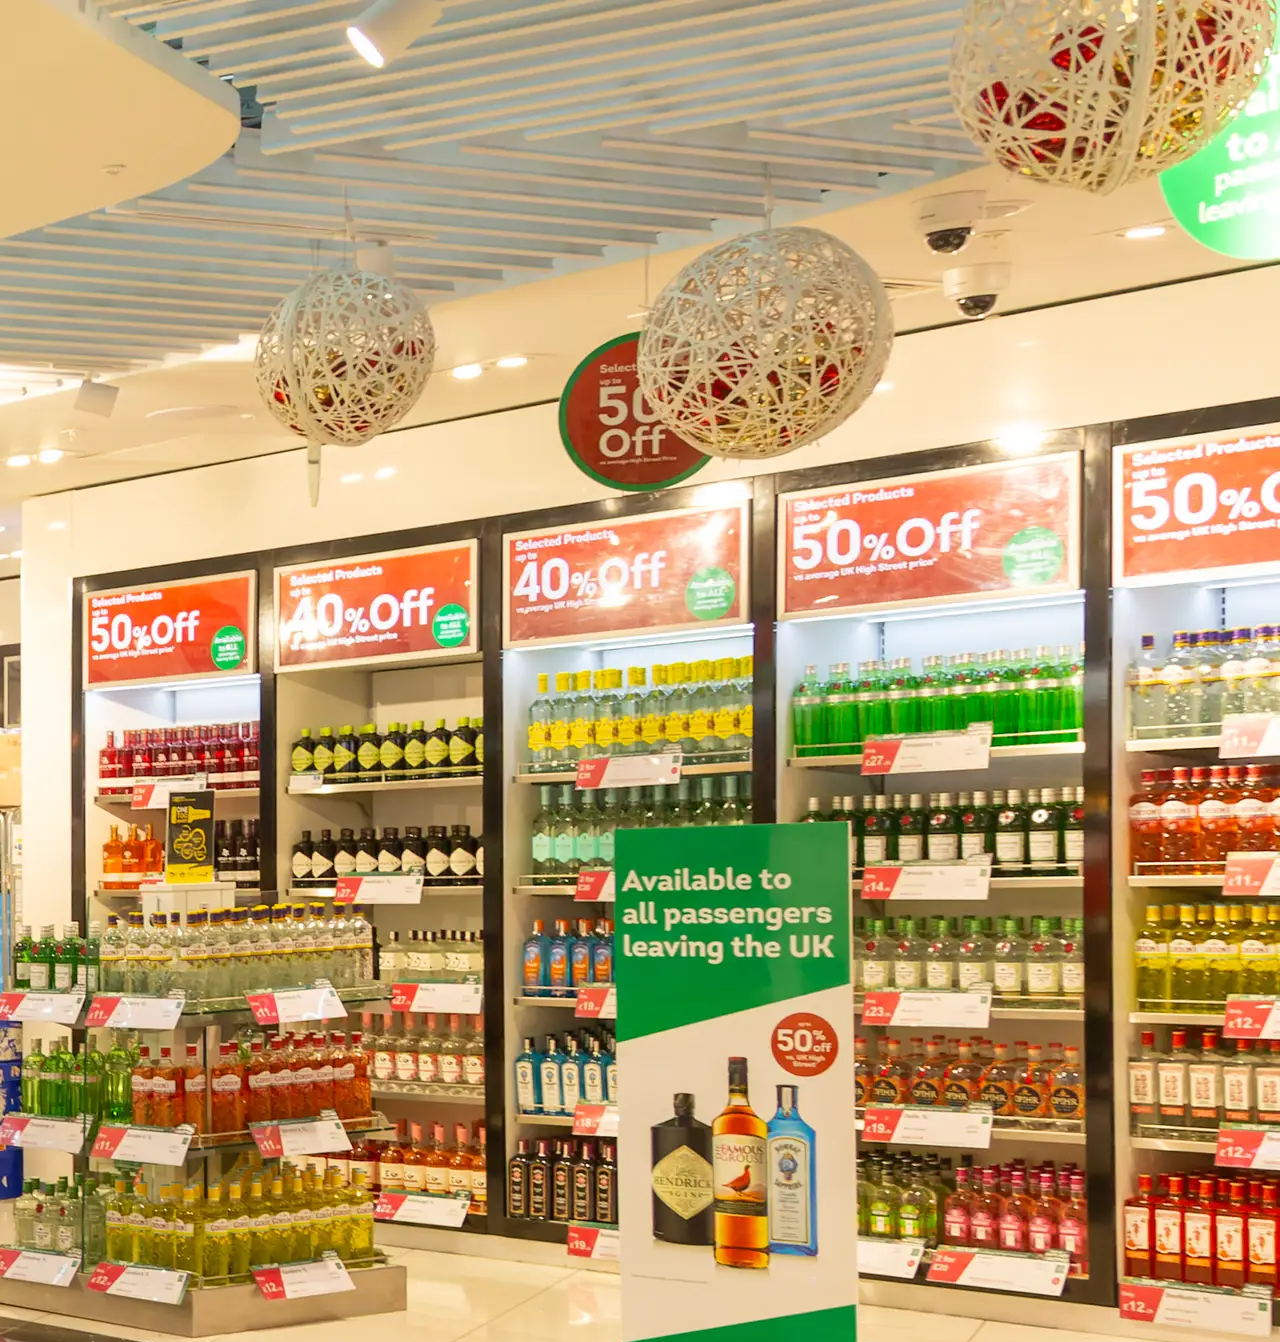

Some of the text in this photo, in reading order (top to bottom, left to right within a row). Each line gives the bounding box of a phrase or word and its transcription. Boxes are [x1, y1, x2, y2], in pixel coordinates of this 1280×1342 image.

[1226, 132, 1270, 162] to
[599, 364, 638, 374] Select
[598, 424, 668, 458] Off
[1132, 443, 1204, 467] Selected
[794, 486, 915, 513] Selected Products
[515, 529, 615, 552] Selected Products
[290, 565, 383, 587] Selected Products
[806, 570, 840, 581] average
[840, 566, 855, 576] UK
[856, 563, 877, 575] High
[878, 561, 908, 573] Street
[92, 591, 163, 608] Selected Products
[622, 867, 792, 892] Available to
[622, 901, 833, 932] all passengers
[623, 934, 835, 965] leaving the UK
[813, 1042, 833, 1053] off
[721, 1144, 764, 1154] FAMOUS
